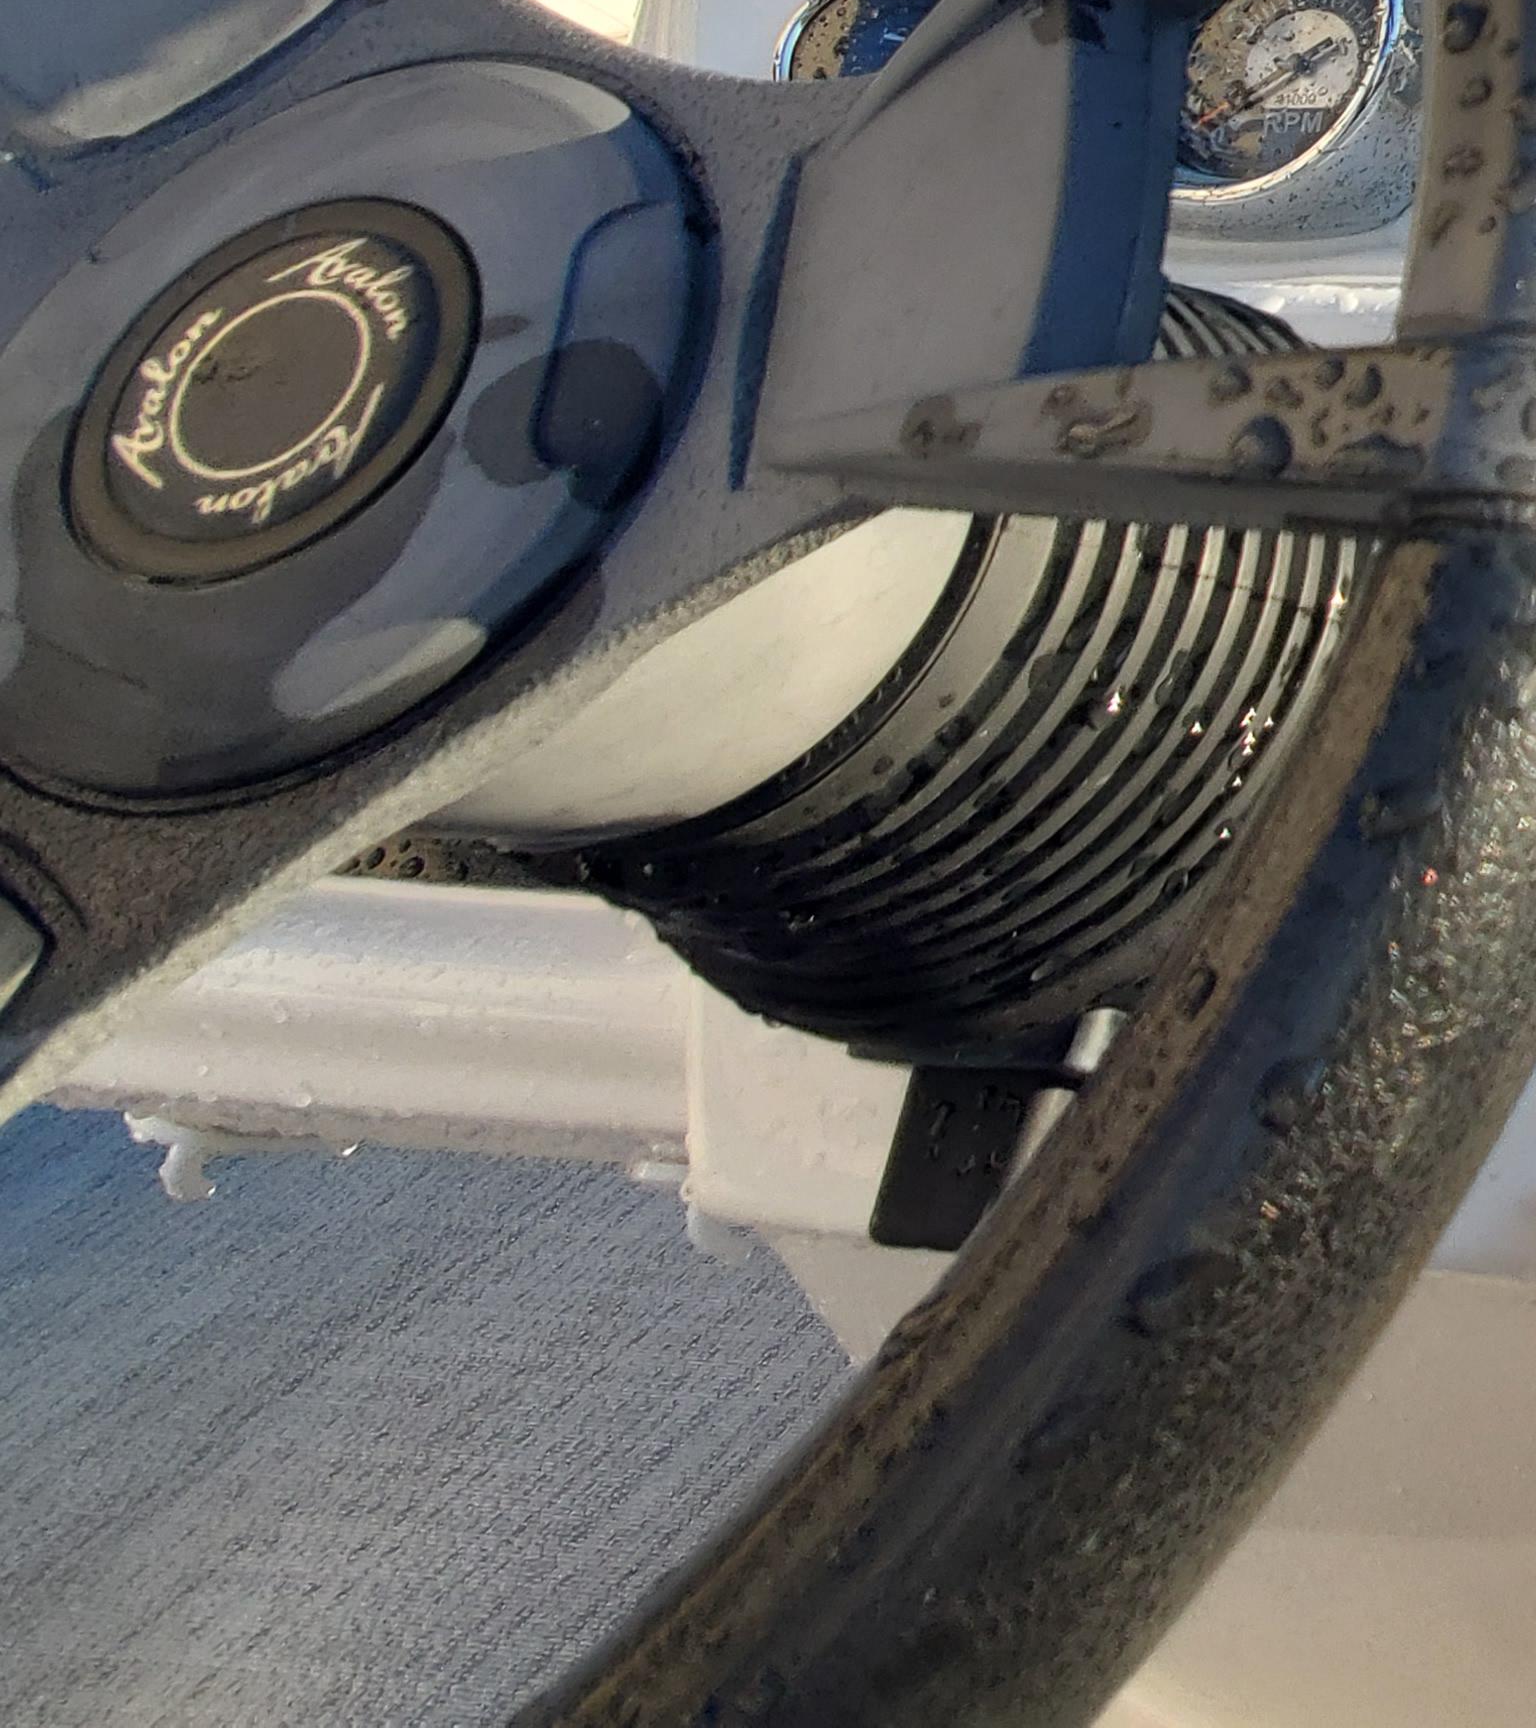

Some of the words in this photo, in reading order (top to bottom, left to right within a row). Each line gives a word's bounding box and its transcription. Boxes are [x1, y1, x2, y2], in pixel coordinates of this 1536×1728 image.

[1265, 110, 1324, 135] RPM
[265, 237, 413, 341] Avalon
[113, 306, 224, 490] Avalon
[195, 382, 384, 524] Avalon
